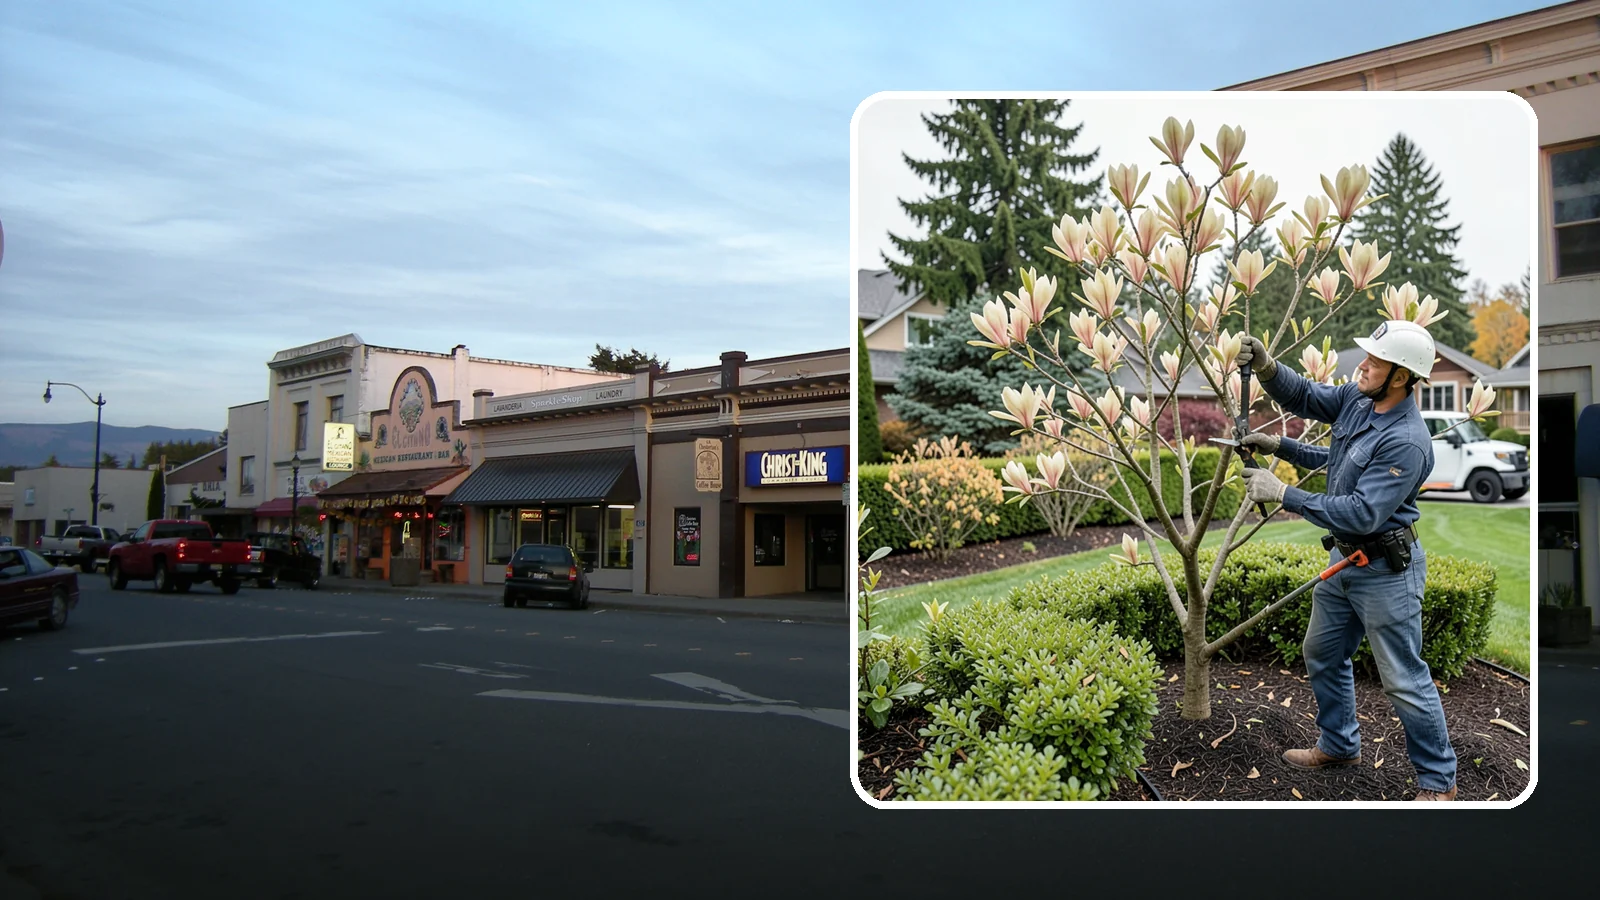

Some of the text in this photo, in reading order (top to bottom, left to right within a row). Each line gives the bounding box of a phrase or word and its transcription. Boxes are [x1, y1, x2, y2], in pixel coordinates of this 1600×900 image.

[493, 389, 623, 412] LAVANDERIA Sparkle Shop LAUNDRY
[374, 450, 450, 464] MEXICAN RESTAURANT BAR
[761, 450, 827, 477] CHRIST KING
